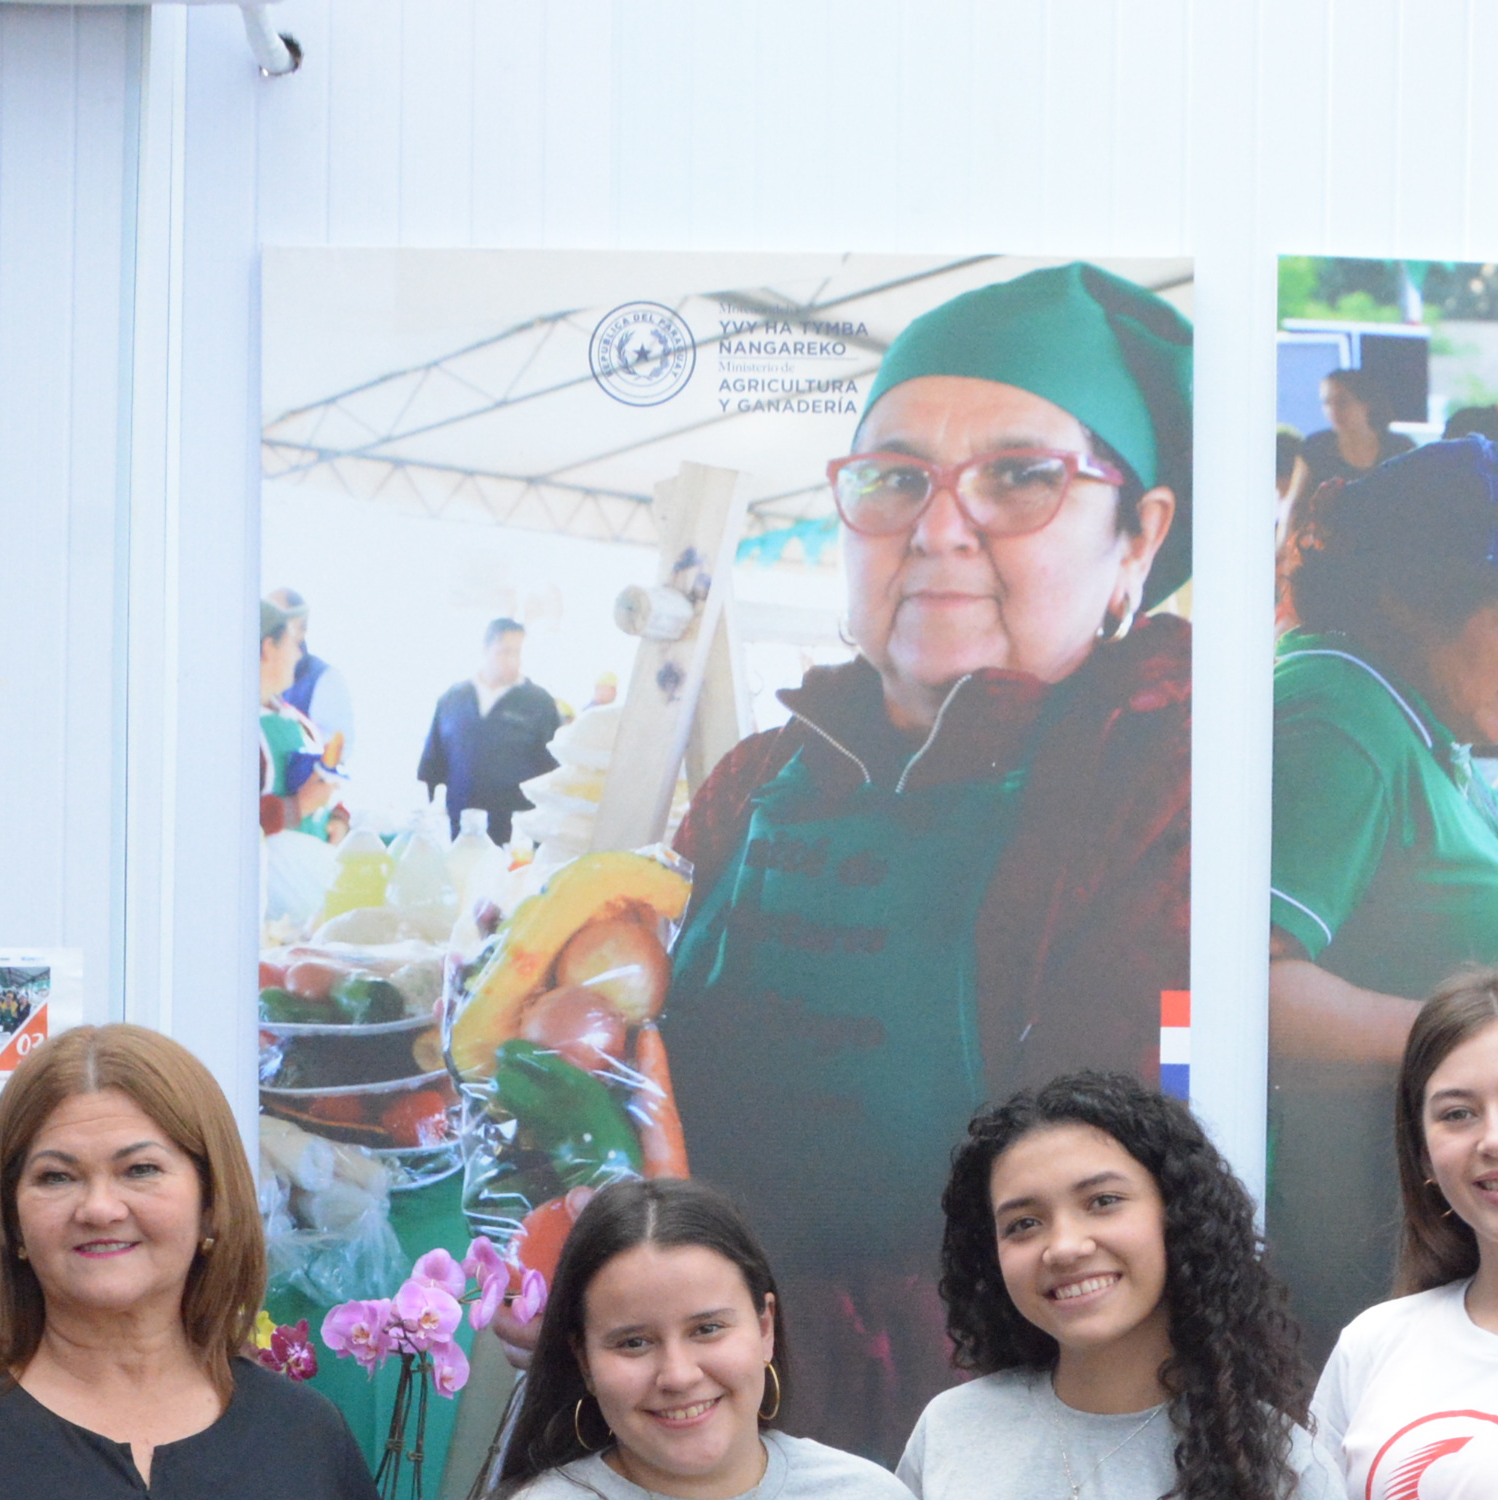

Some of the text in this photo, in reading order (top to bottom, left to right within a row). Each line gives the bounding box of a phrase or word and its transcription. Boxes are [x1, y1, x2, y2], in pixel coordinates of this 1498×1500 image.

[633, 313, 654, 322] DEL
[719, 320, 869, 336] YVY HA TYMBA
[719, 336, 846, 356] ÑANGAREKO
[719, 361, 795, 373] Ministerio de
[719, 378, 858, 393] AGRICULTURA
[719, 396, 857, 414] Y GANADERÍA
